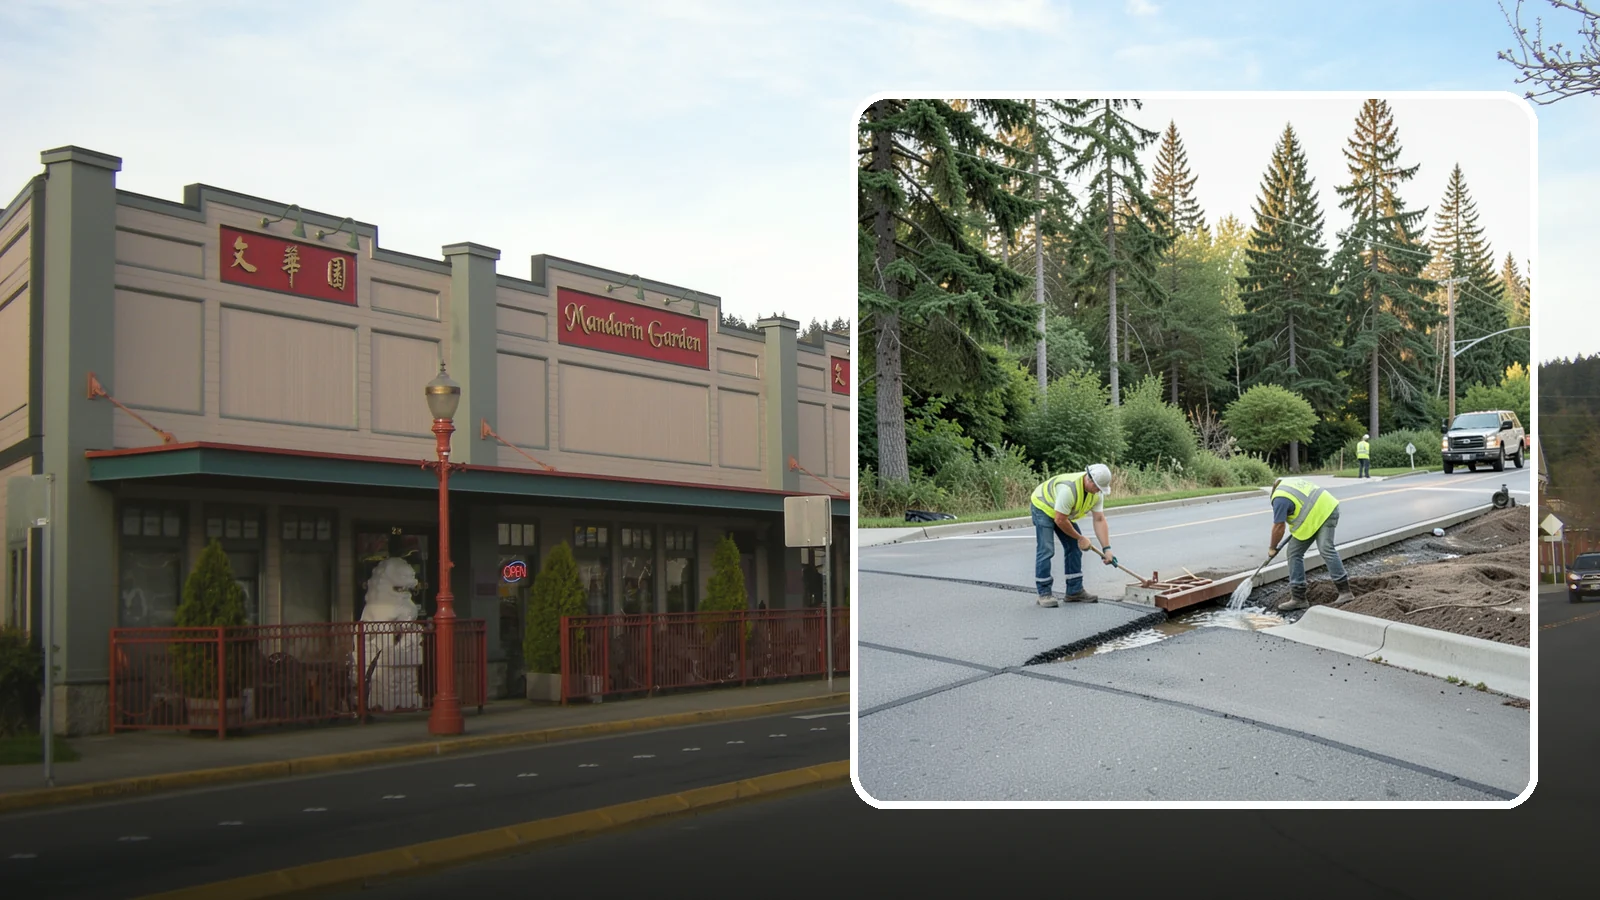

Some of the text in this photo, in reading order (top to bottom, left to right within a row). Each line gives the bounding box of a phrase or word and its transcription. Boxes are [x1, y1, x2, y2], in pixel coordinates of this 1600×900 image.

[231, 236, 346, 290] 文華園
[564, 302, 701, 352] Mandarin Garden
[503, 565, 527, 578] OPEN
